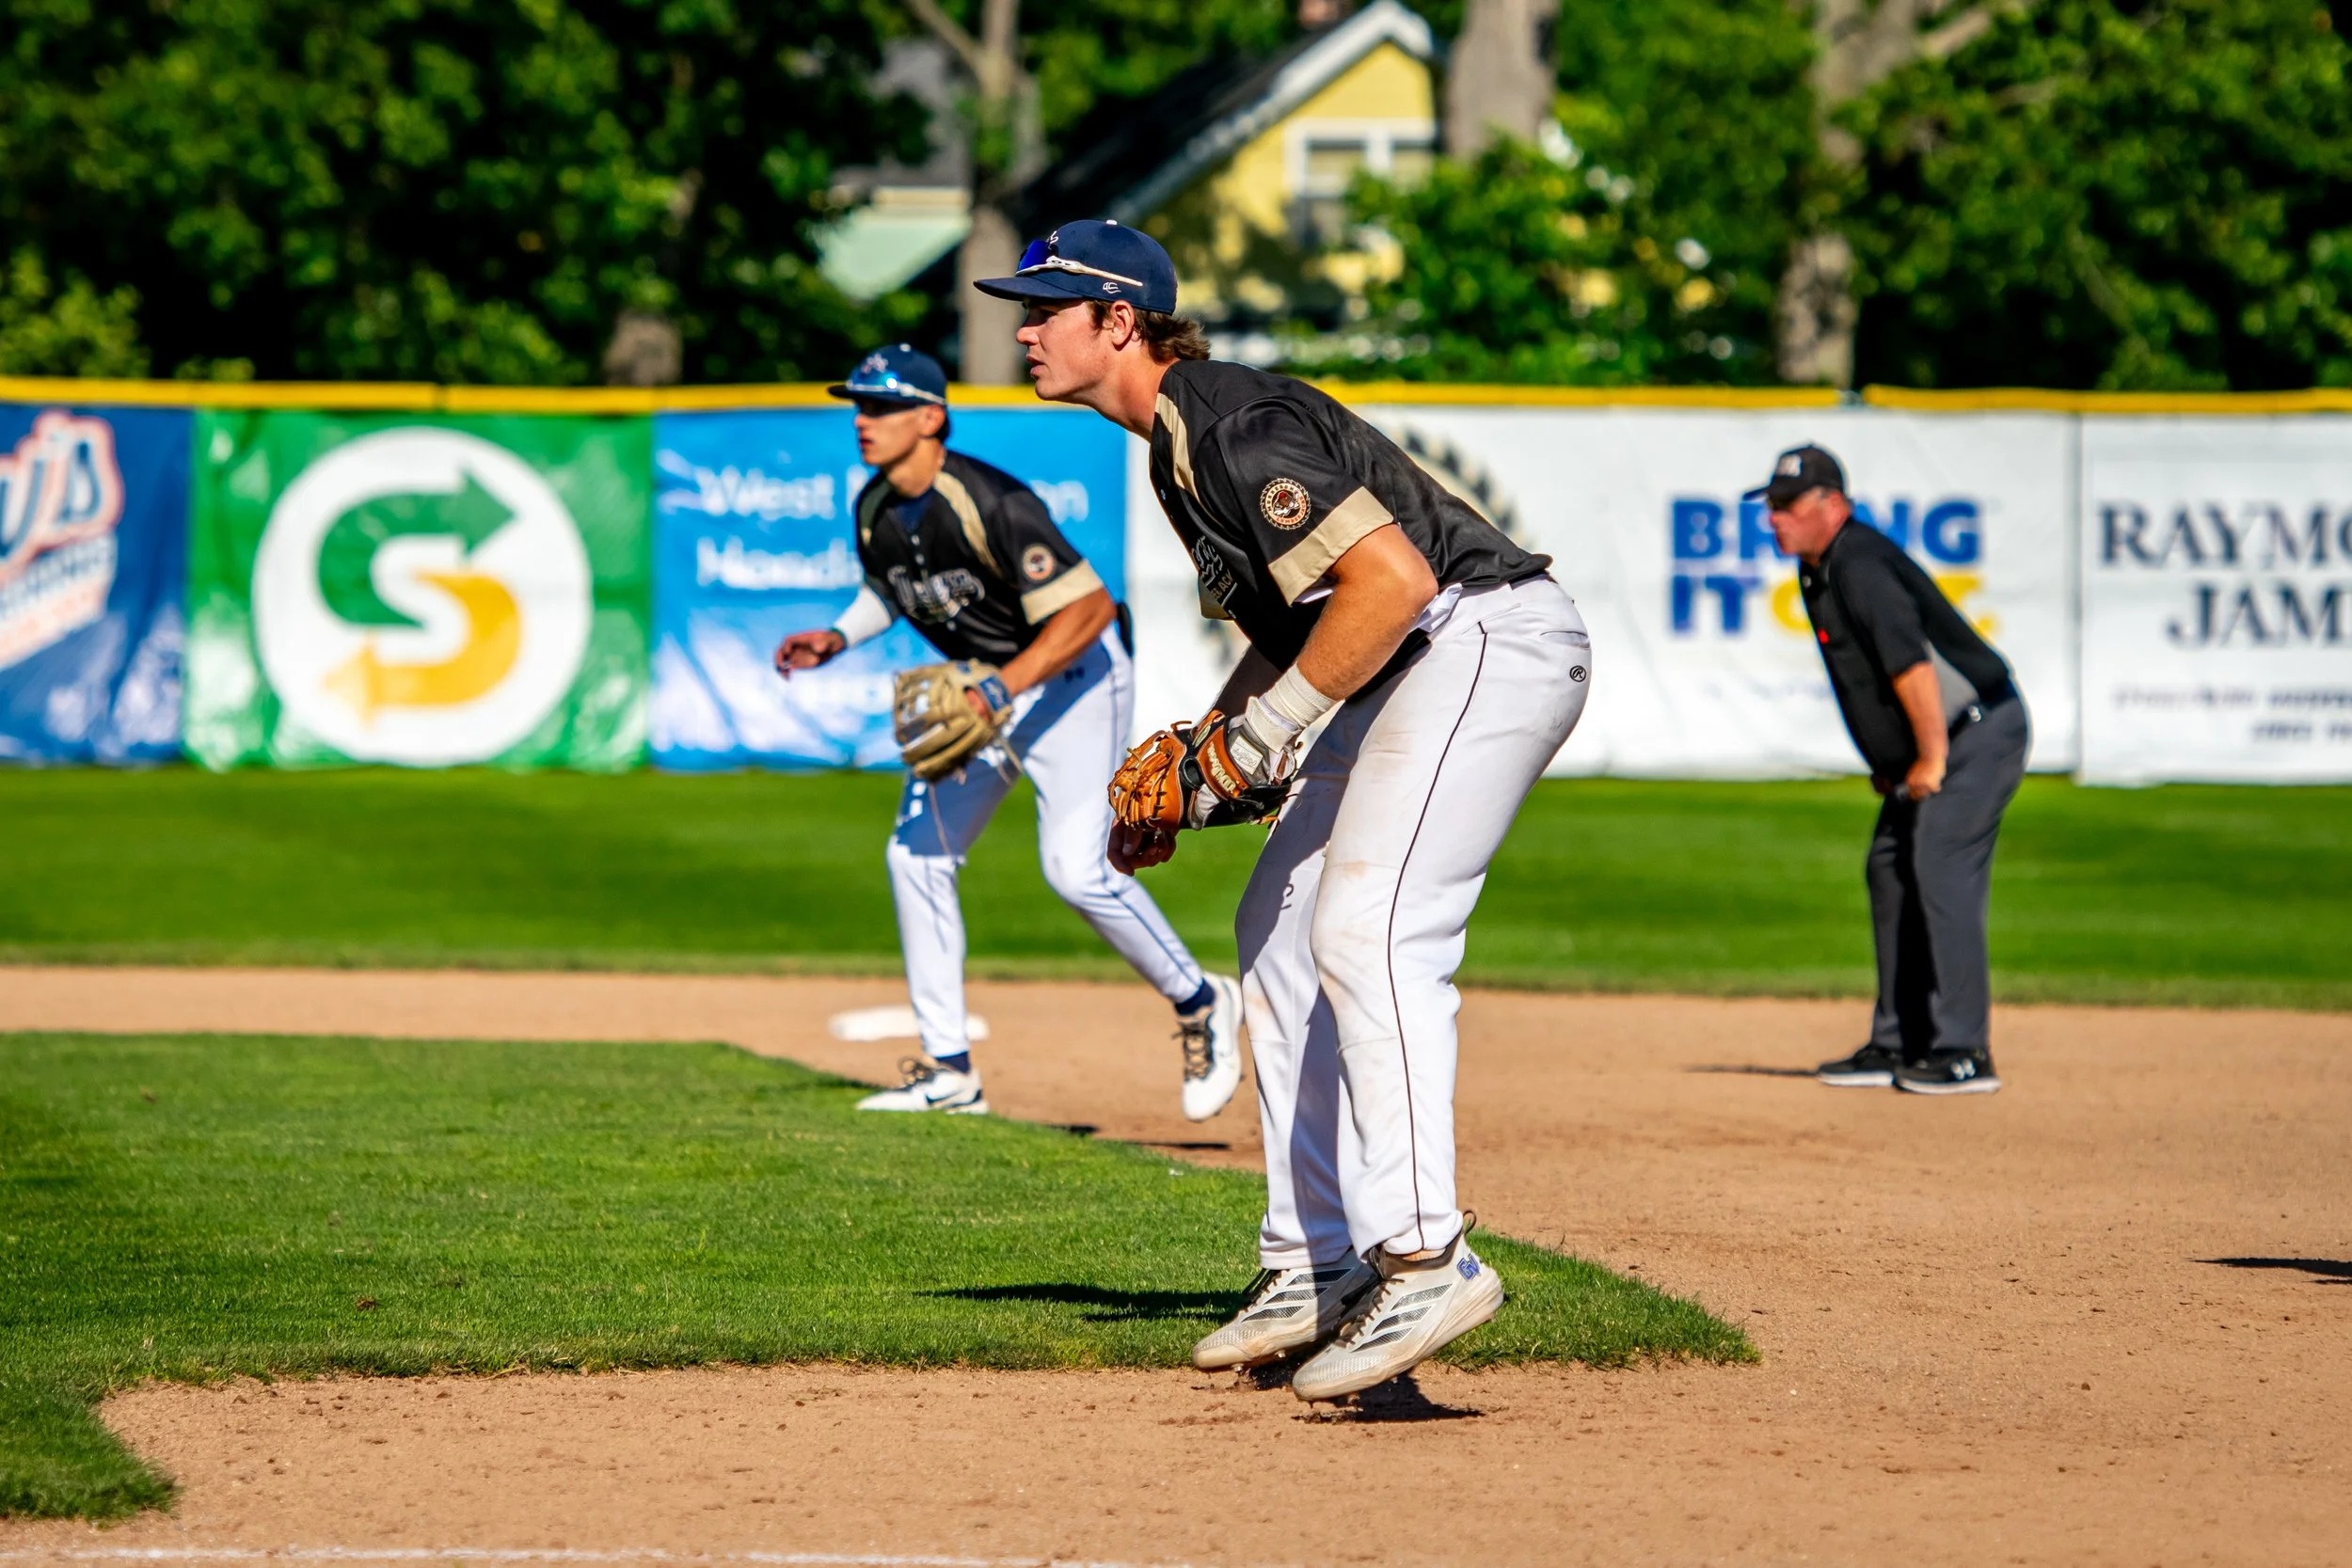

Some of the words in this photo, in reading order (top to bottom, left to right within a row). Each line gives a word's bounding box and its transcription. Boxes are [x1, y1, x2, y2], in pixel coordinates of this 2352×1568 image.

[698, 467, 834, 518] West
[1674, 500, 1981, 563] BRNG
[2100, 506, 2352, 566] RAYM
[1674, 575, 1760, 632] IT
[2166, 582, 2352, 647] JAM
